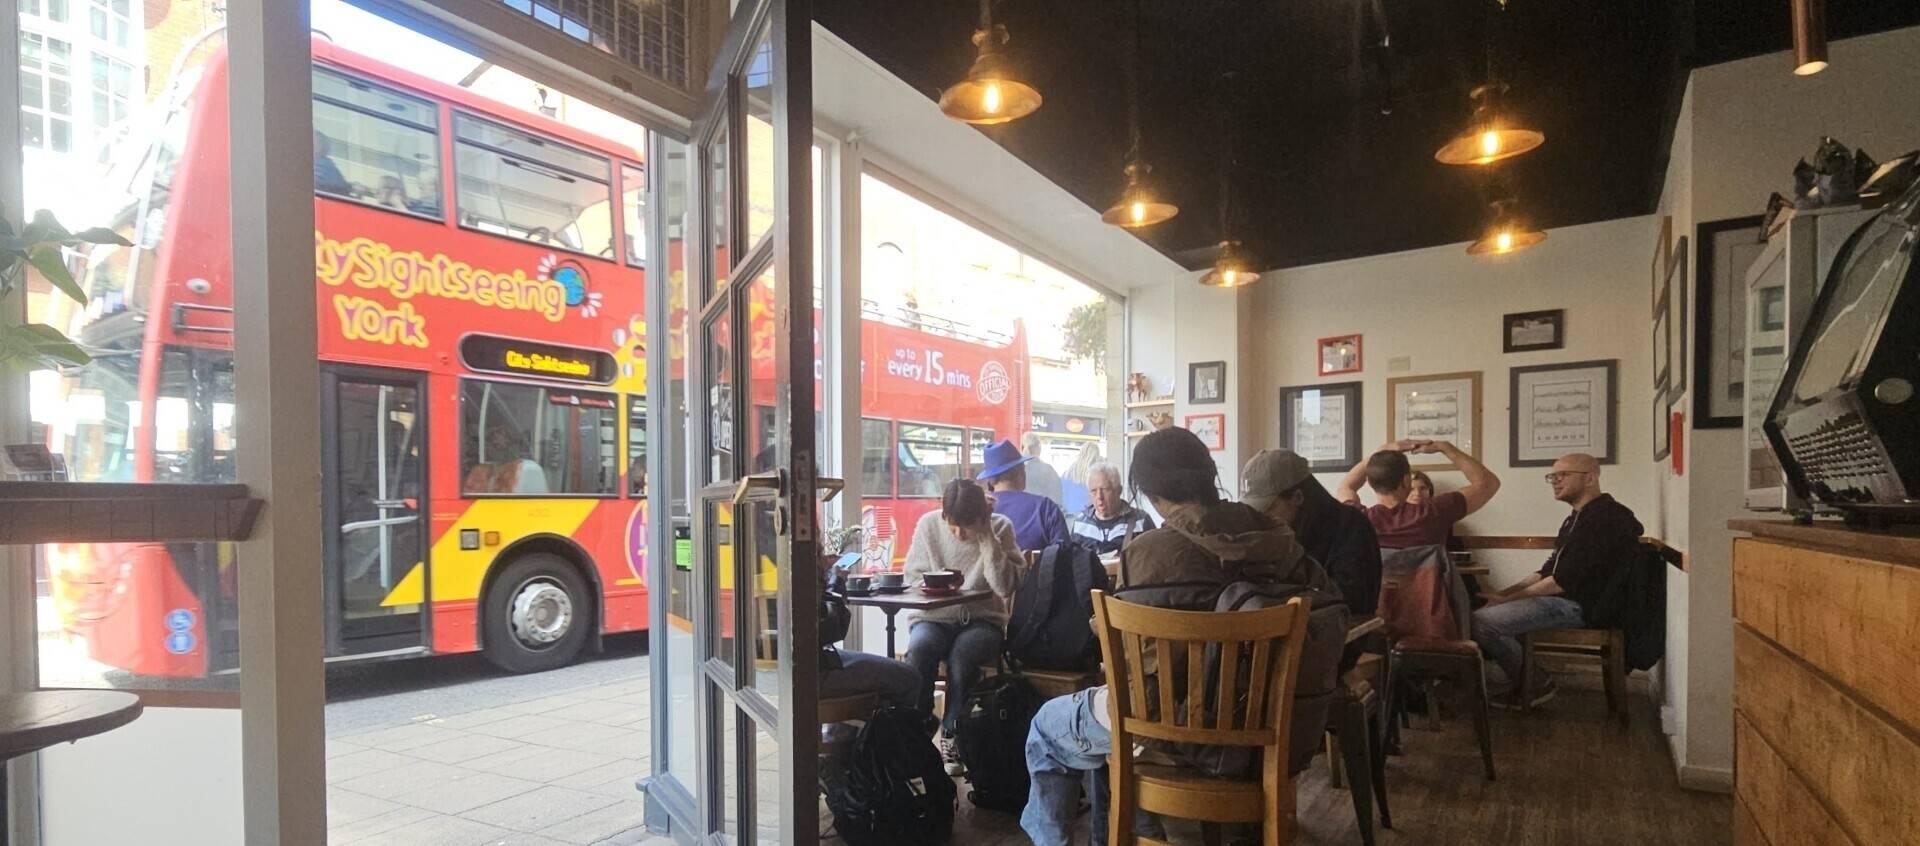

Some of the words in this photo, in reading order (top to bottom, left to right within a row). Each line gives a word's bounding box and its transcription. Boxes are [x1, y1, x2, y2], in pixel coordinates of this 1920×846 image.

[895, 348, 905, 360] up
[906, 348, 916, 360] to
[888, 359, 923, 382] every
[925, 349, 944, 386] 15
[946, 369, 972, 389] mins
